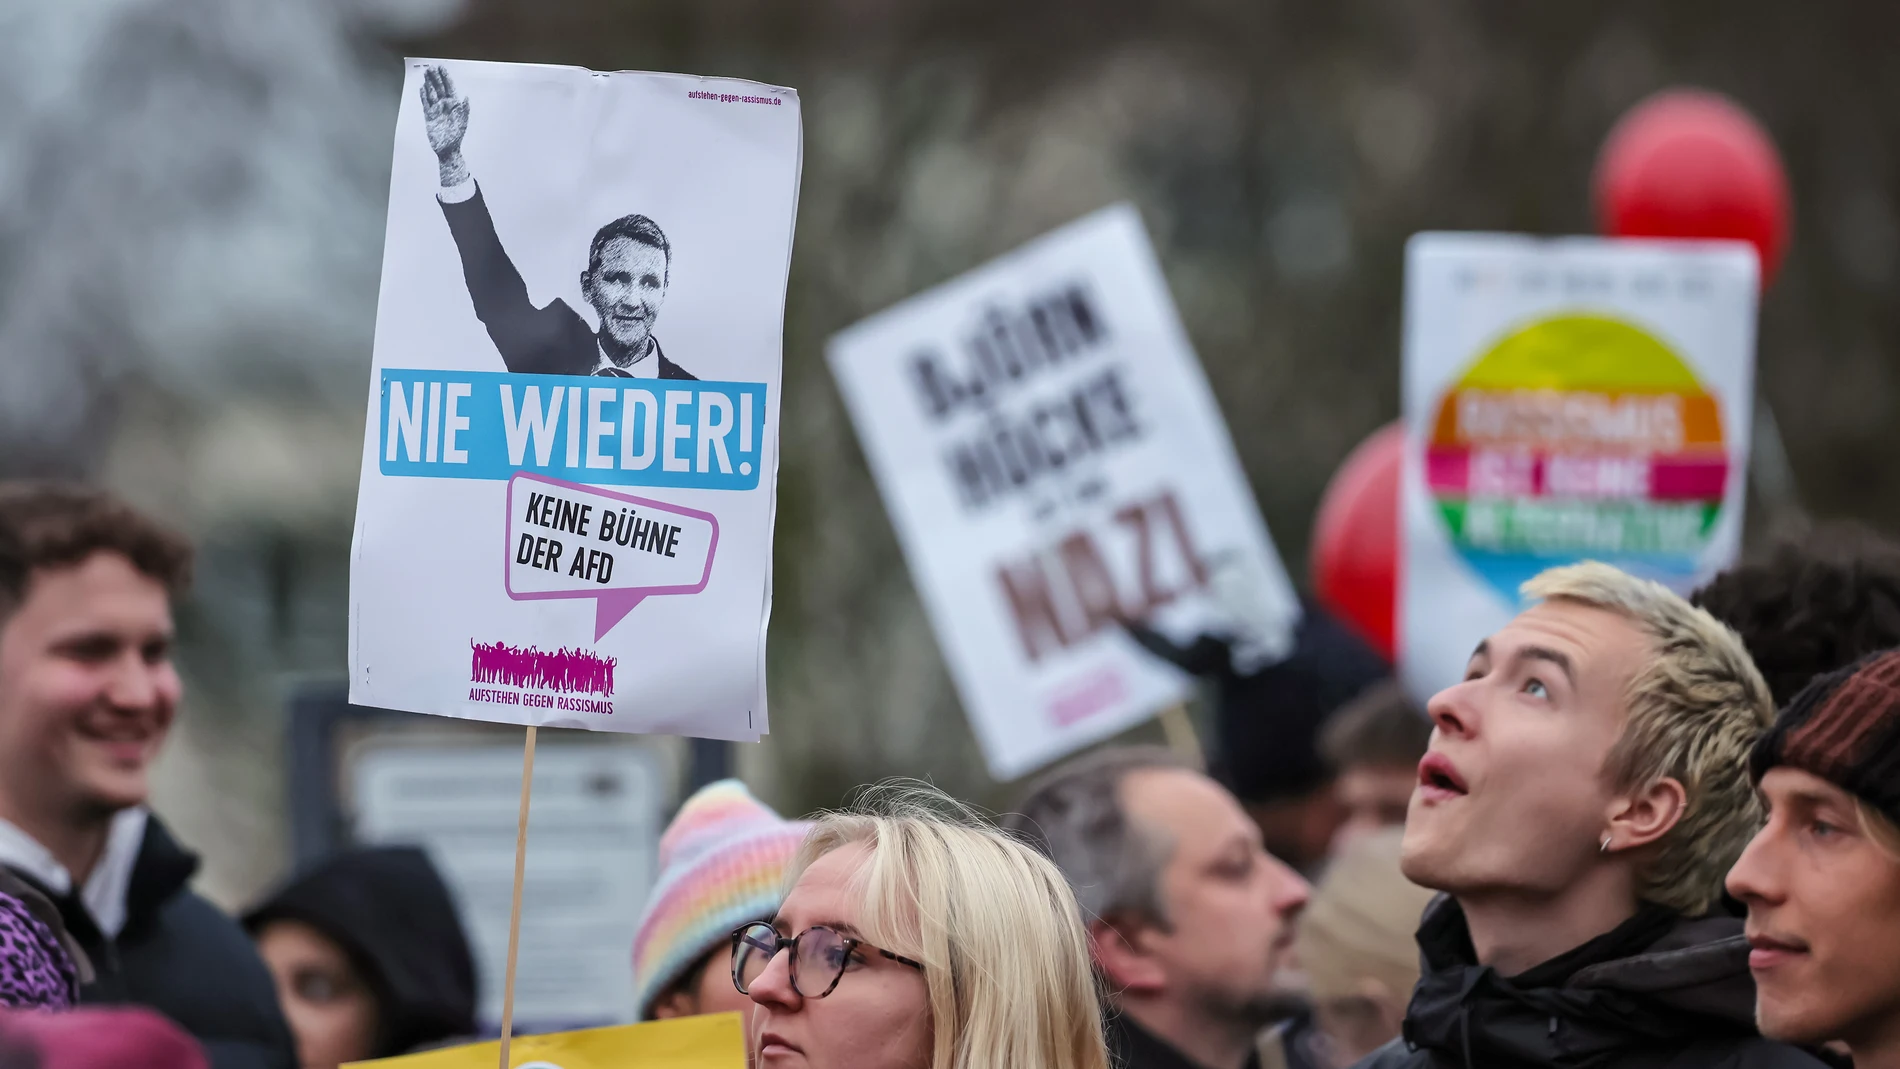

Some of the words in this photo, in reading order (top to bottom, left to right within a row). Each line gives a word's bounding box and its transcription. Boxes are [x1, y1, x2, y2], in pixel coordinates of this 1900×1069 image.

[688, 90, 782, 106] aufstehen-gegen-rassismus.de
[385, 380, 472, 464] NIE
[499, 384, 753, 476] WIEDER!
[525, 492, 592, 537] KEINE
[598, 507, 682, 558] BÜHNE
[516, 533, 561, 573] DER
[568, 551, 615, 584] AFD
[997, 493, 1210, 662] NAZI
[469, 687, 519, 706] AUFSTEHEN
[523, 693, 553, 708] GEGEN
[557, 696, 614, 715] RASSISMUS
